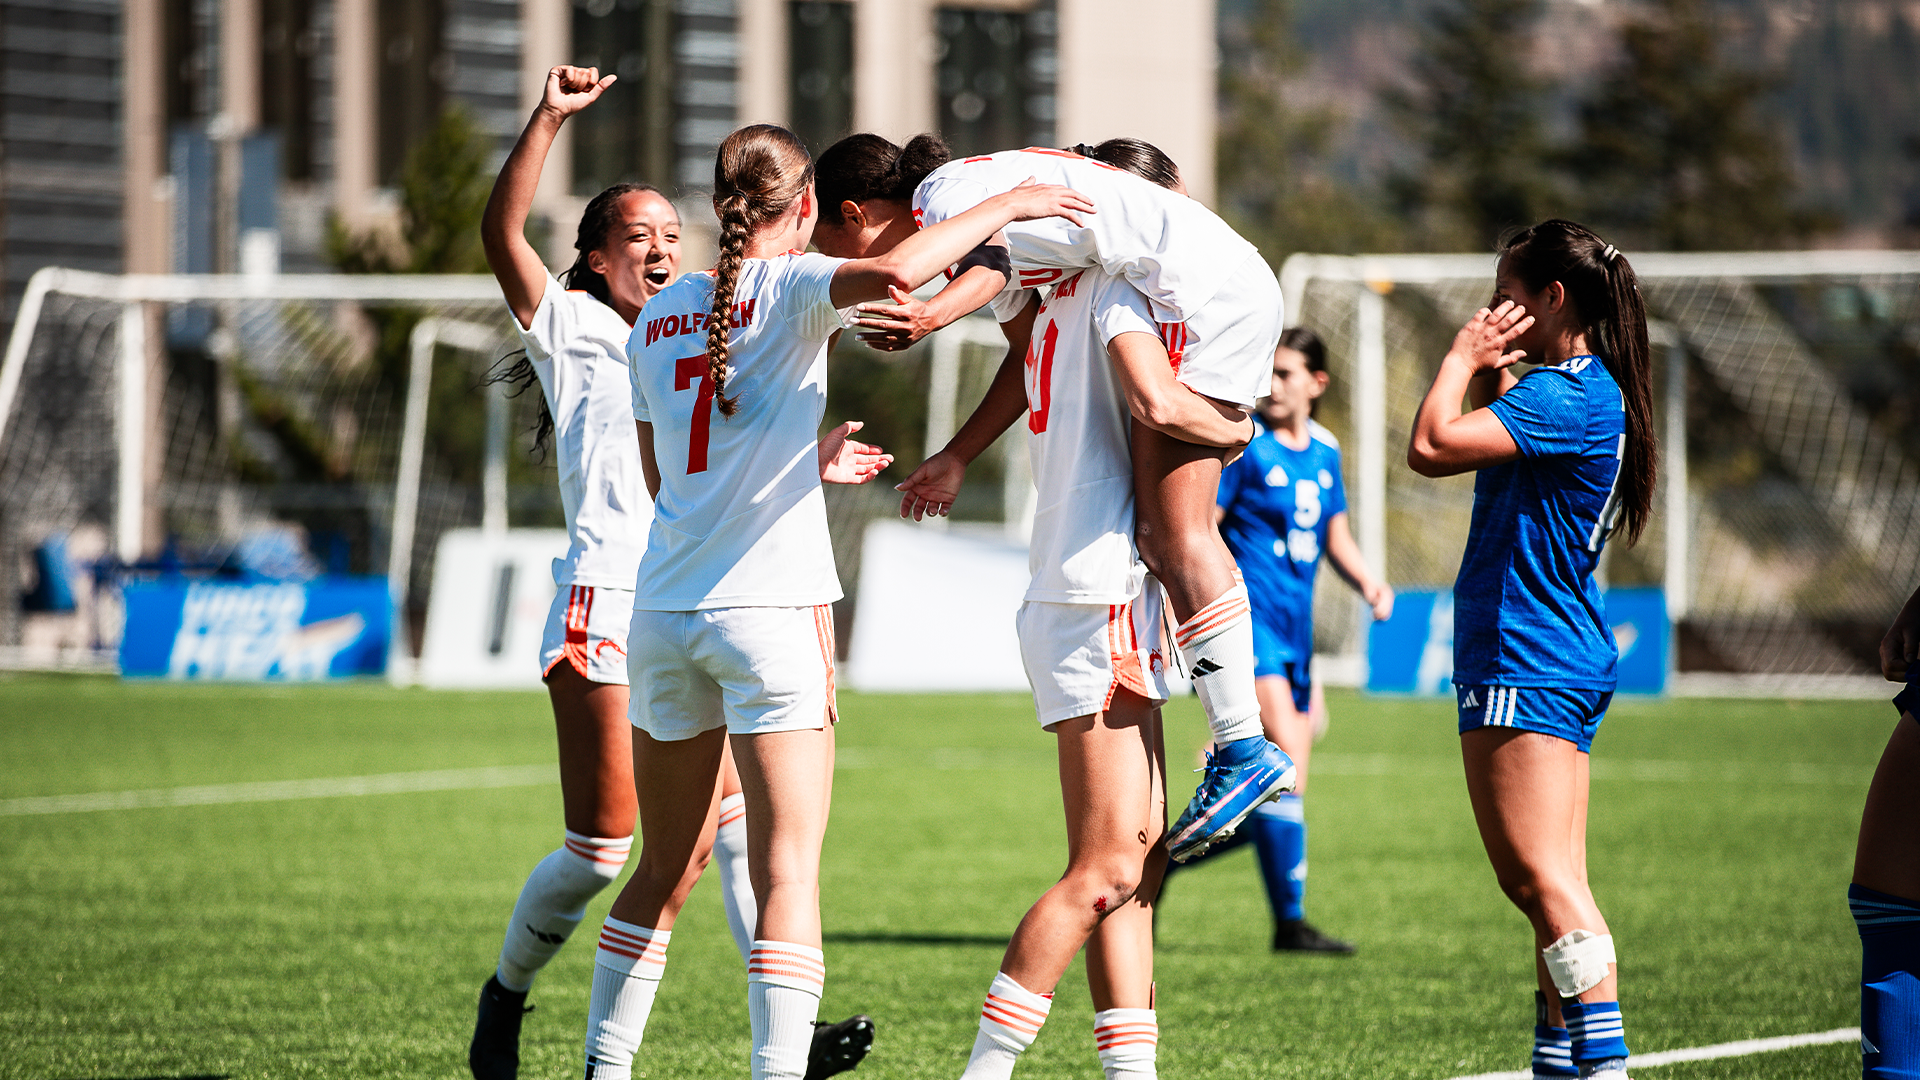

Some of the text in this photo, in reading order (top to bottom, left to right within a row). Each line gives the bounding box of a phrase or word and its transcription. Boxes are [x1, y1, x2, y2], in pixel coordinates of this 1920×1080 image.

[645, 298, 756, 348] WOLFCK
[674, 353, 716, 475] 7
[1293, 479, 1321, 529] 5
